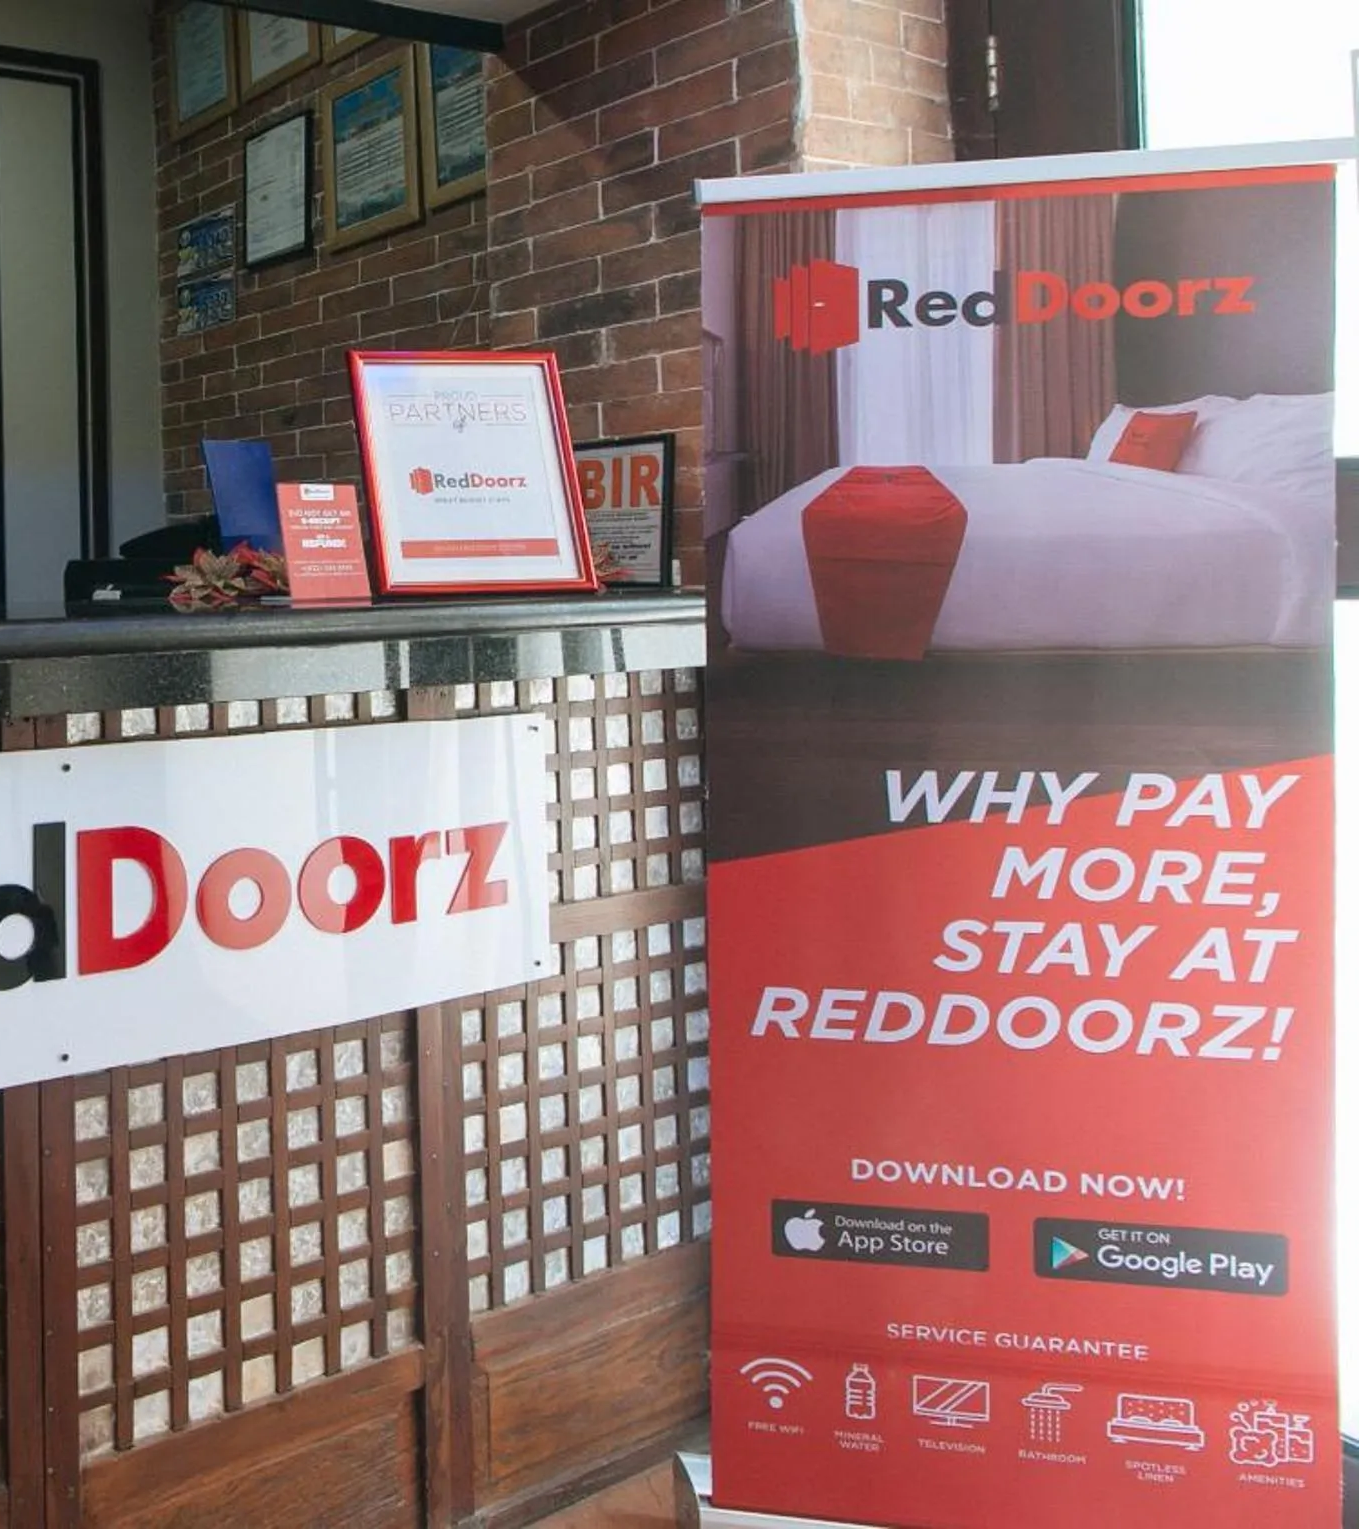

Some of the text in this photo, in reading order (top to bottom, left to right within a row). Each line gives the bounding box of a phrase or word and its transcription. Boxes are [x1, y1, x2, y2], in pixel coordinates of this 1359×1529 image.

[867, 269, 1257, 330] RedDoorz
[389, 402, 527, 422] PARTNERS
[434, 472, 527, 489] RedDoorz
[578, 455, 660, 510] BIR
[885, 769, 1301, 829] WHY PAY
[991, 846, 1282, 918] MORE,
[933, 918, 1300, 984] STAY AT
[750, 986, 1295, 1061] REDDOORZ!
[850, 1157, 1186, 1201] DOWNLOAD NOW!
[834, 1215, 953, 1235] Download on the
[837, 1230, 950, 1256] App Store
[1097, 1228, 1171, 1245] GET IT ON
[1097, 1244, 1275, 1287] Google Play
[886, 1323, 1150, 1362] SERVICE GUARANTEE
[747, 1421, 777, 1433] FREE
[833, 1430, 885, 1444] MINERAL
[840, 1440, 880, 1452] WATER
[917, 1438, 986, 1454] TELEVISION
[1017, 1449, 1087, 1465] BATHROOM
[1125, 1460, 1187, 1475] SPOTLESS
[1137, 1471, 1175, 1484] LINEN
[1239, 1473, 1306, 1489] AMENITIES
